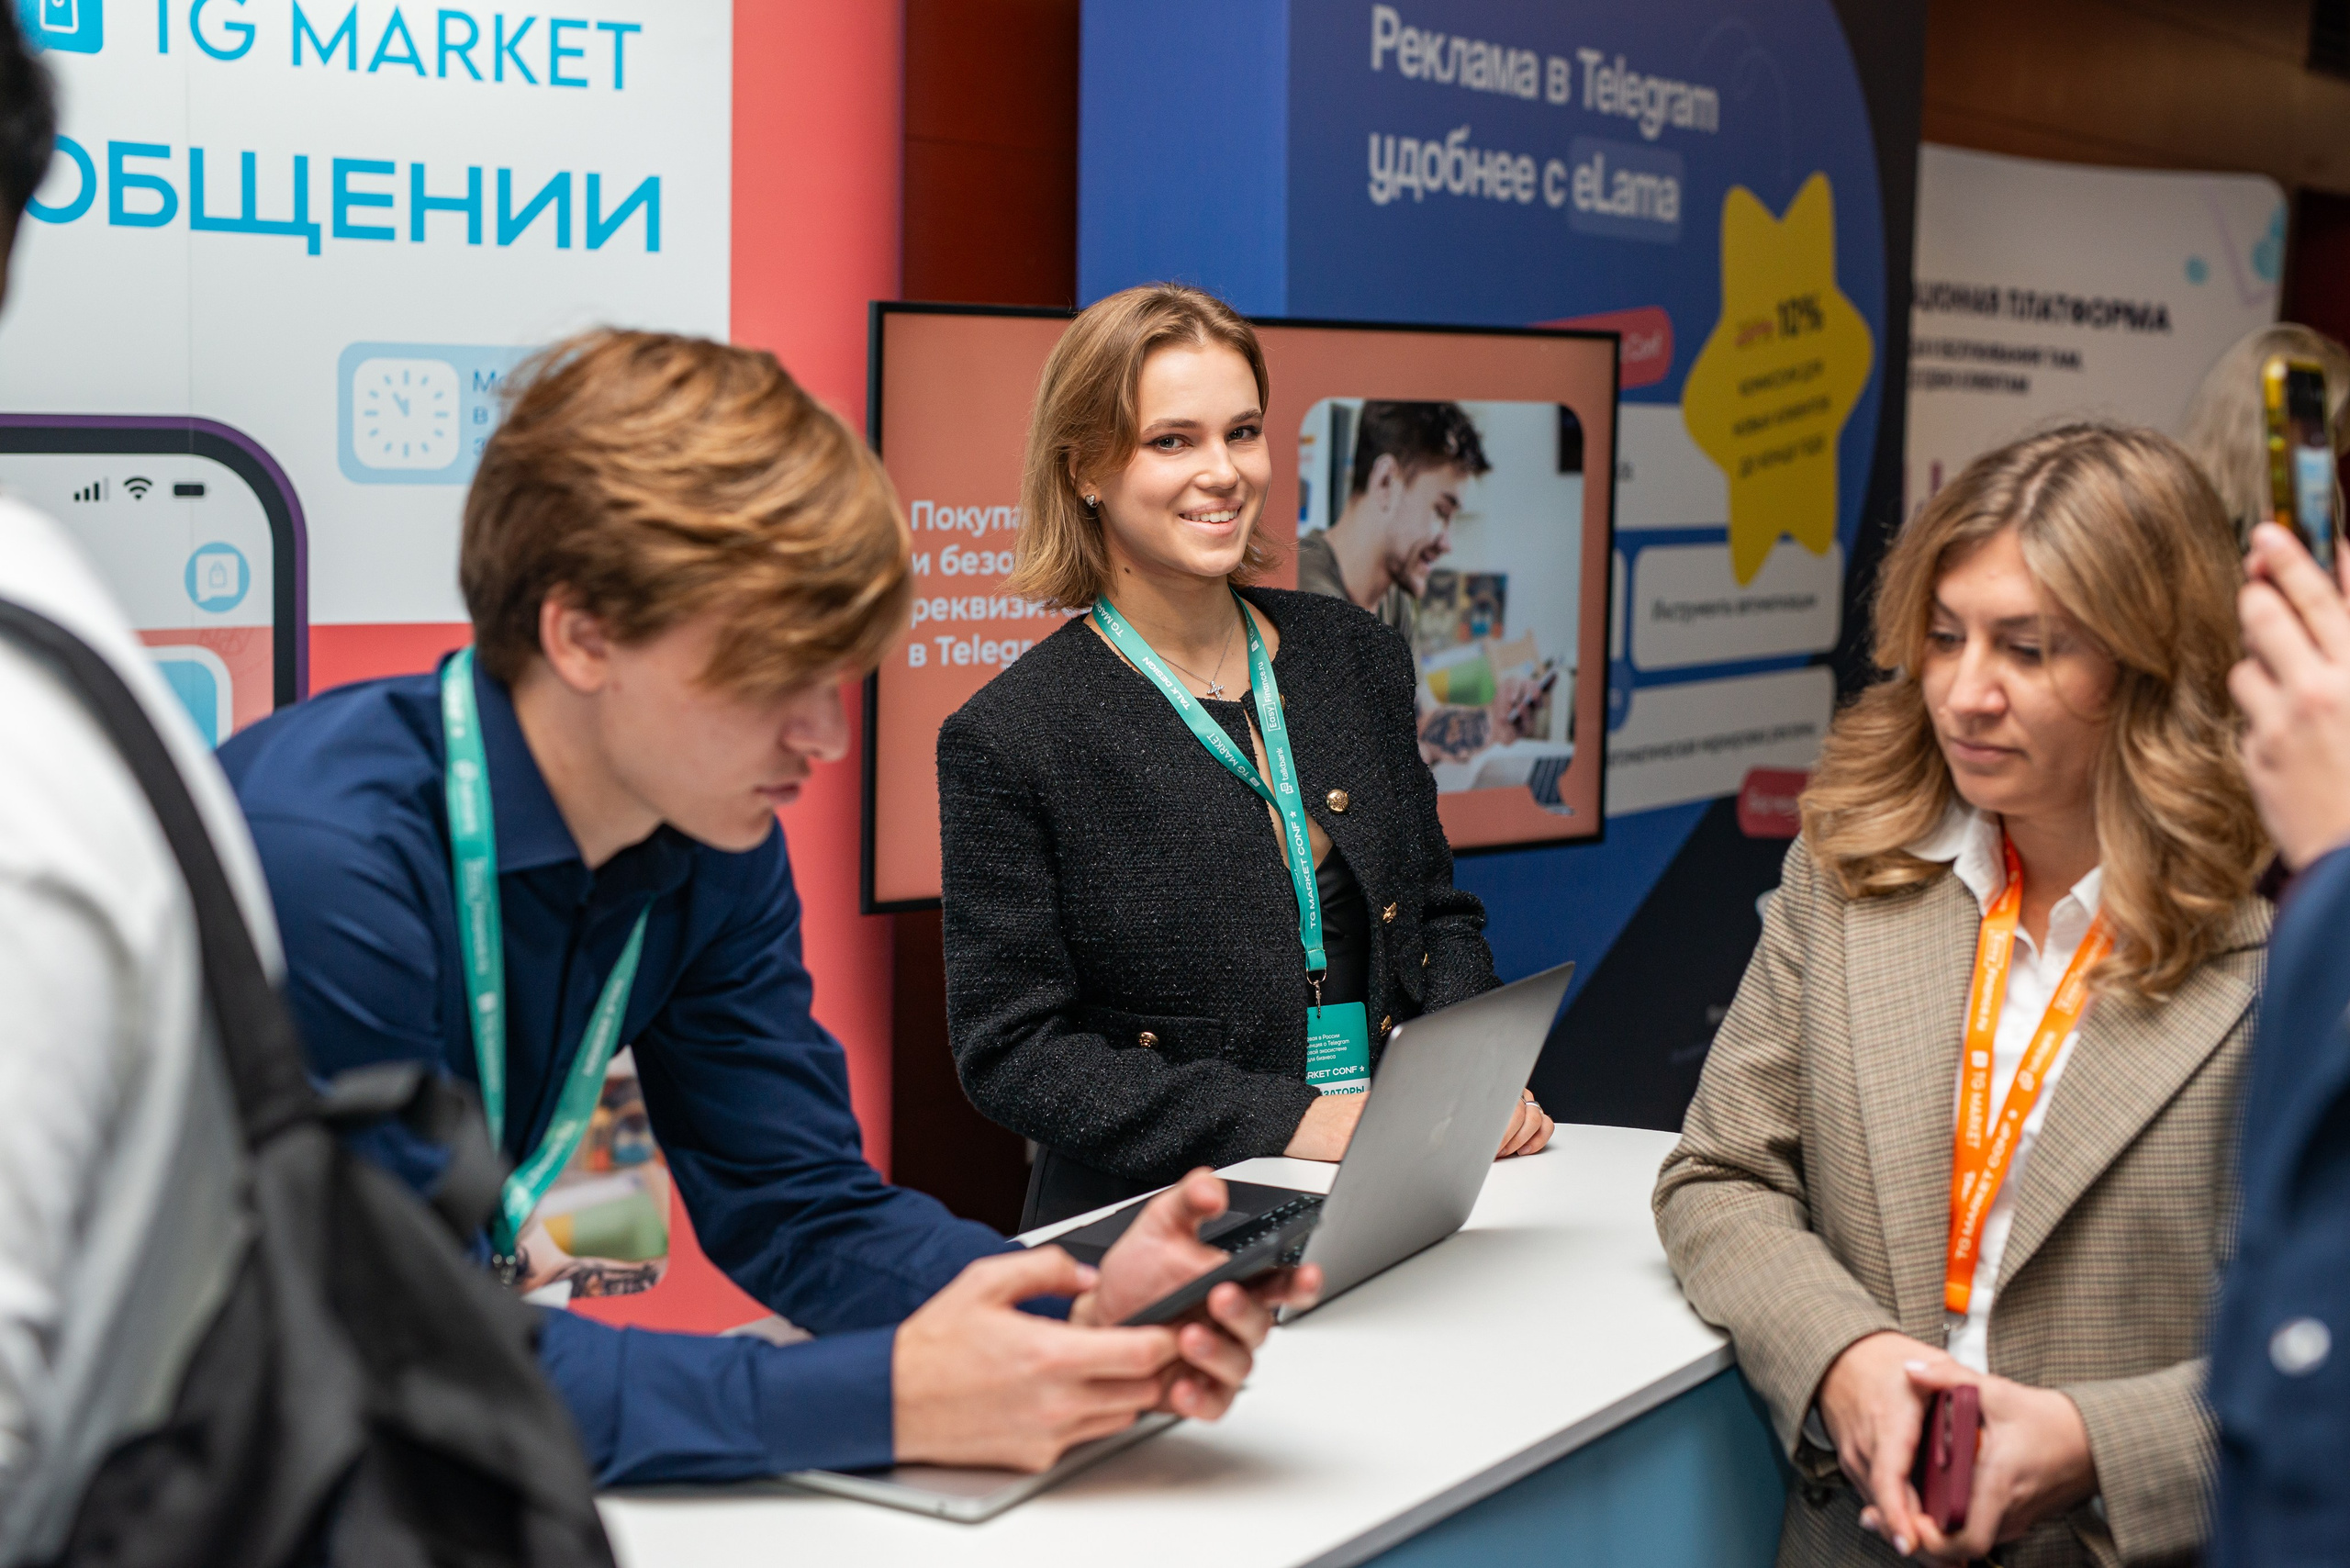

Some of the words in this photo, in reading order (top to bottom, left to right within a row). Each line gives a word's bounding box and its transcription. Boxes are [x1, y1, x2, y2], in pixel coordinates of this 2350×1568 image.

[292, 0, 642, 91] MARKET
[1371, 4, 1539, 100] Реклама
[1546, 57, 1572, 106] в
[1576, 48, 1719, 140] Telegram
[1368, 125, 1538, 206] удобнее
[1543, 158, 1568, 207] с
[1572, 151, 1681, 224] eLama
[26, 133, 662, 256] ОБЩЕНИИ
[1110, 622, 1125, 638] TG
[908, 643, 927, 668] в
[1142, 656, 1173, 688] DESIGN
[1170, 686, 1191, 711] TALK
[1258, 661, 1273, 702] Finance.ru
[1268, 706, 1278, 729] Easy
[1206, 733, 1239, 767] MARKET
[1276, 746, 1290, 781] talkbank
[1237, 766, 1249, 778] TG
[1291, 822, 1305, 856] CONF
[1299, 860, 1316, 912] MARKET
[1309, 913, 1317, 930] TG
[1306, 1069, 1331, 1080] RKET
[1332, 1066, 1358, 1076] CONF
